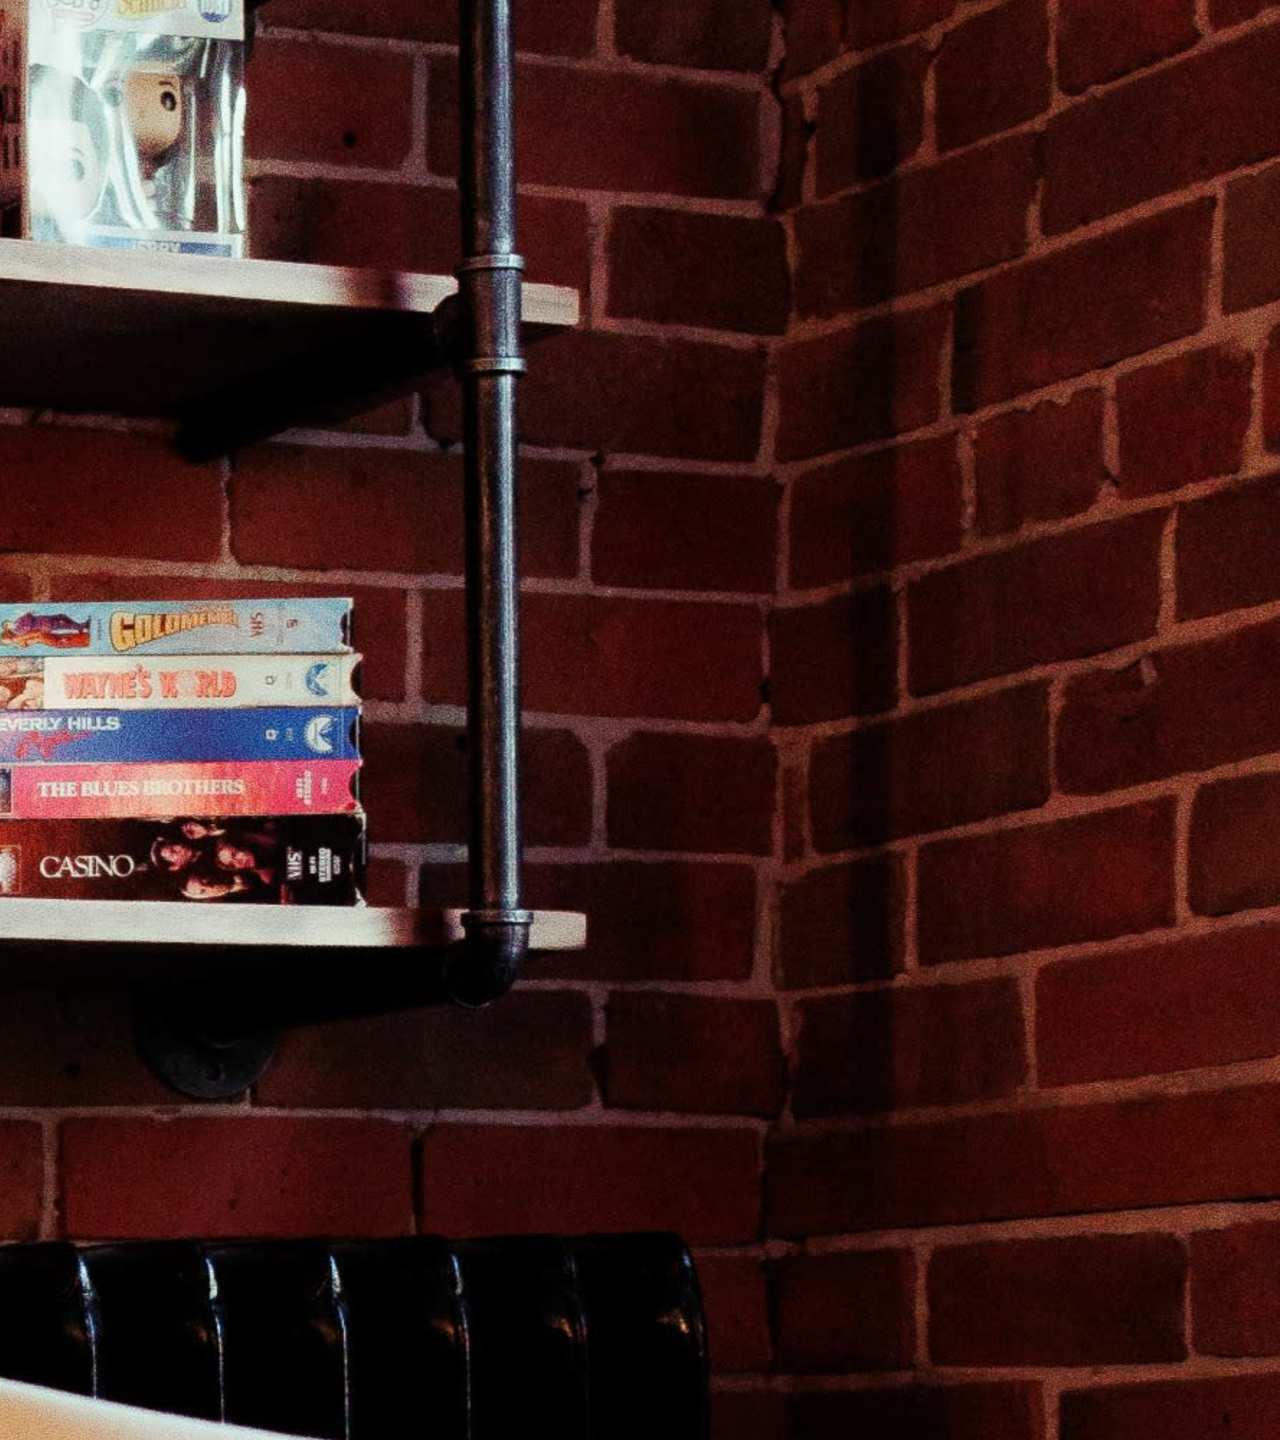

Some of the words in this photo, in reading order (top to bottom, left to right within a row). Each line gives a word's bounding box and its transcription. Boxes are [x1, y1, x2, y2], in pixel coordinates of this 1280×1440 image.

[64, 664, 153, 699] WAYNE'S
[68, 715, 122, 731] HILLS
[36, 780, 78, 798] THE
[81, 779, 139, 797] BLUES
[142, 778, 246, 796] BROTHERS
[39, 853, 136, 879] CASINO
